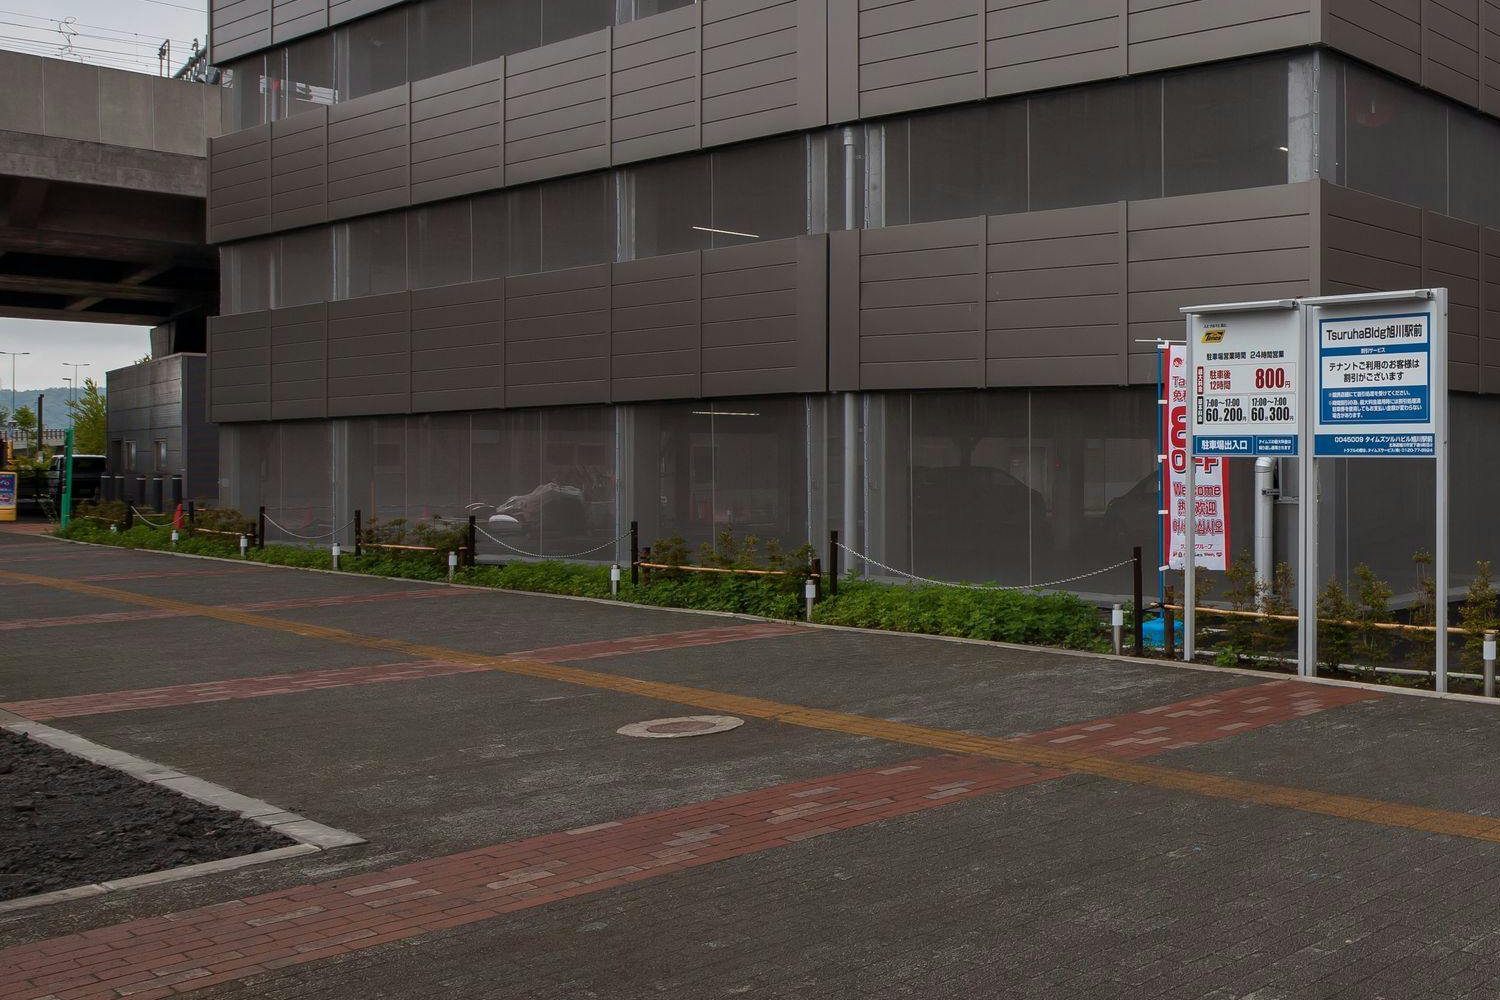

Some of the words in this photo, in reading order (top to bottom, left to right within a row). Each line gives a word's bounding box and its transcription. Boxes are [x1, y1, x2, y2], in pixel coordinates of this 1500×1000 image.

[1326, 323, 1423, 341] TsuruhaBldg旭川駅前
[1329, 359, 1420, 372] テナントご利用のお客様は
[1209, 370, 1231, 380] 駐車後
[1343, 371, 1405, 383] 割引がございます
[1209, 380, 1231, 390] 12時間
[1201, 440, 1248, 450] 駐車場出入口
